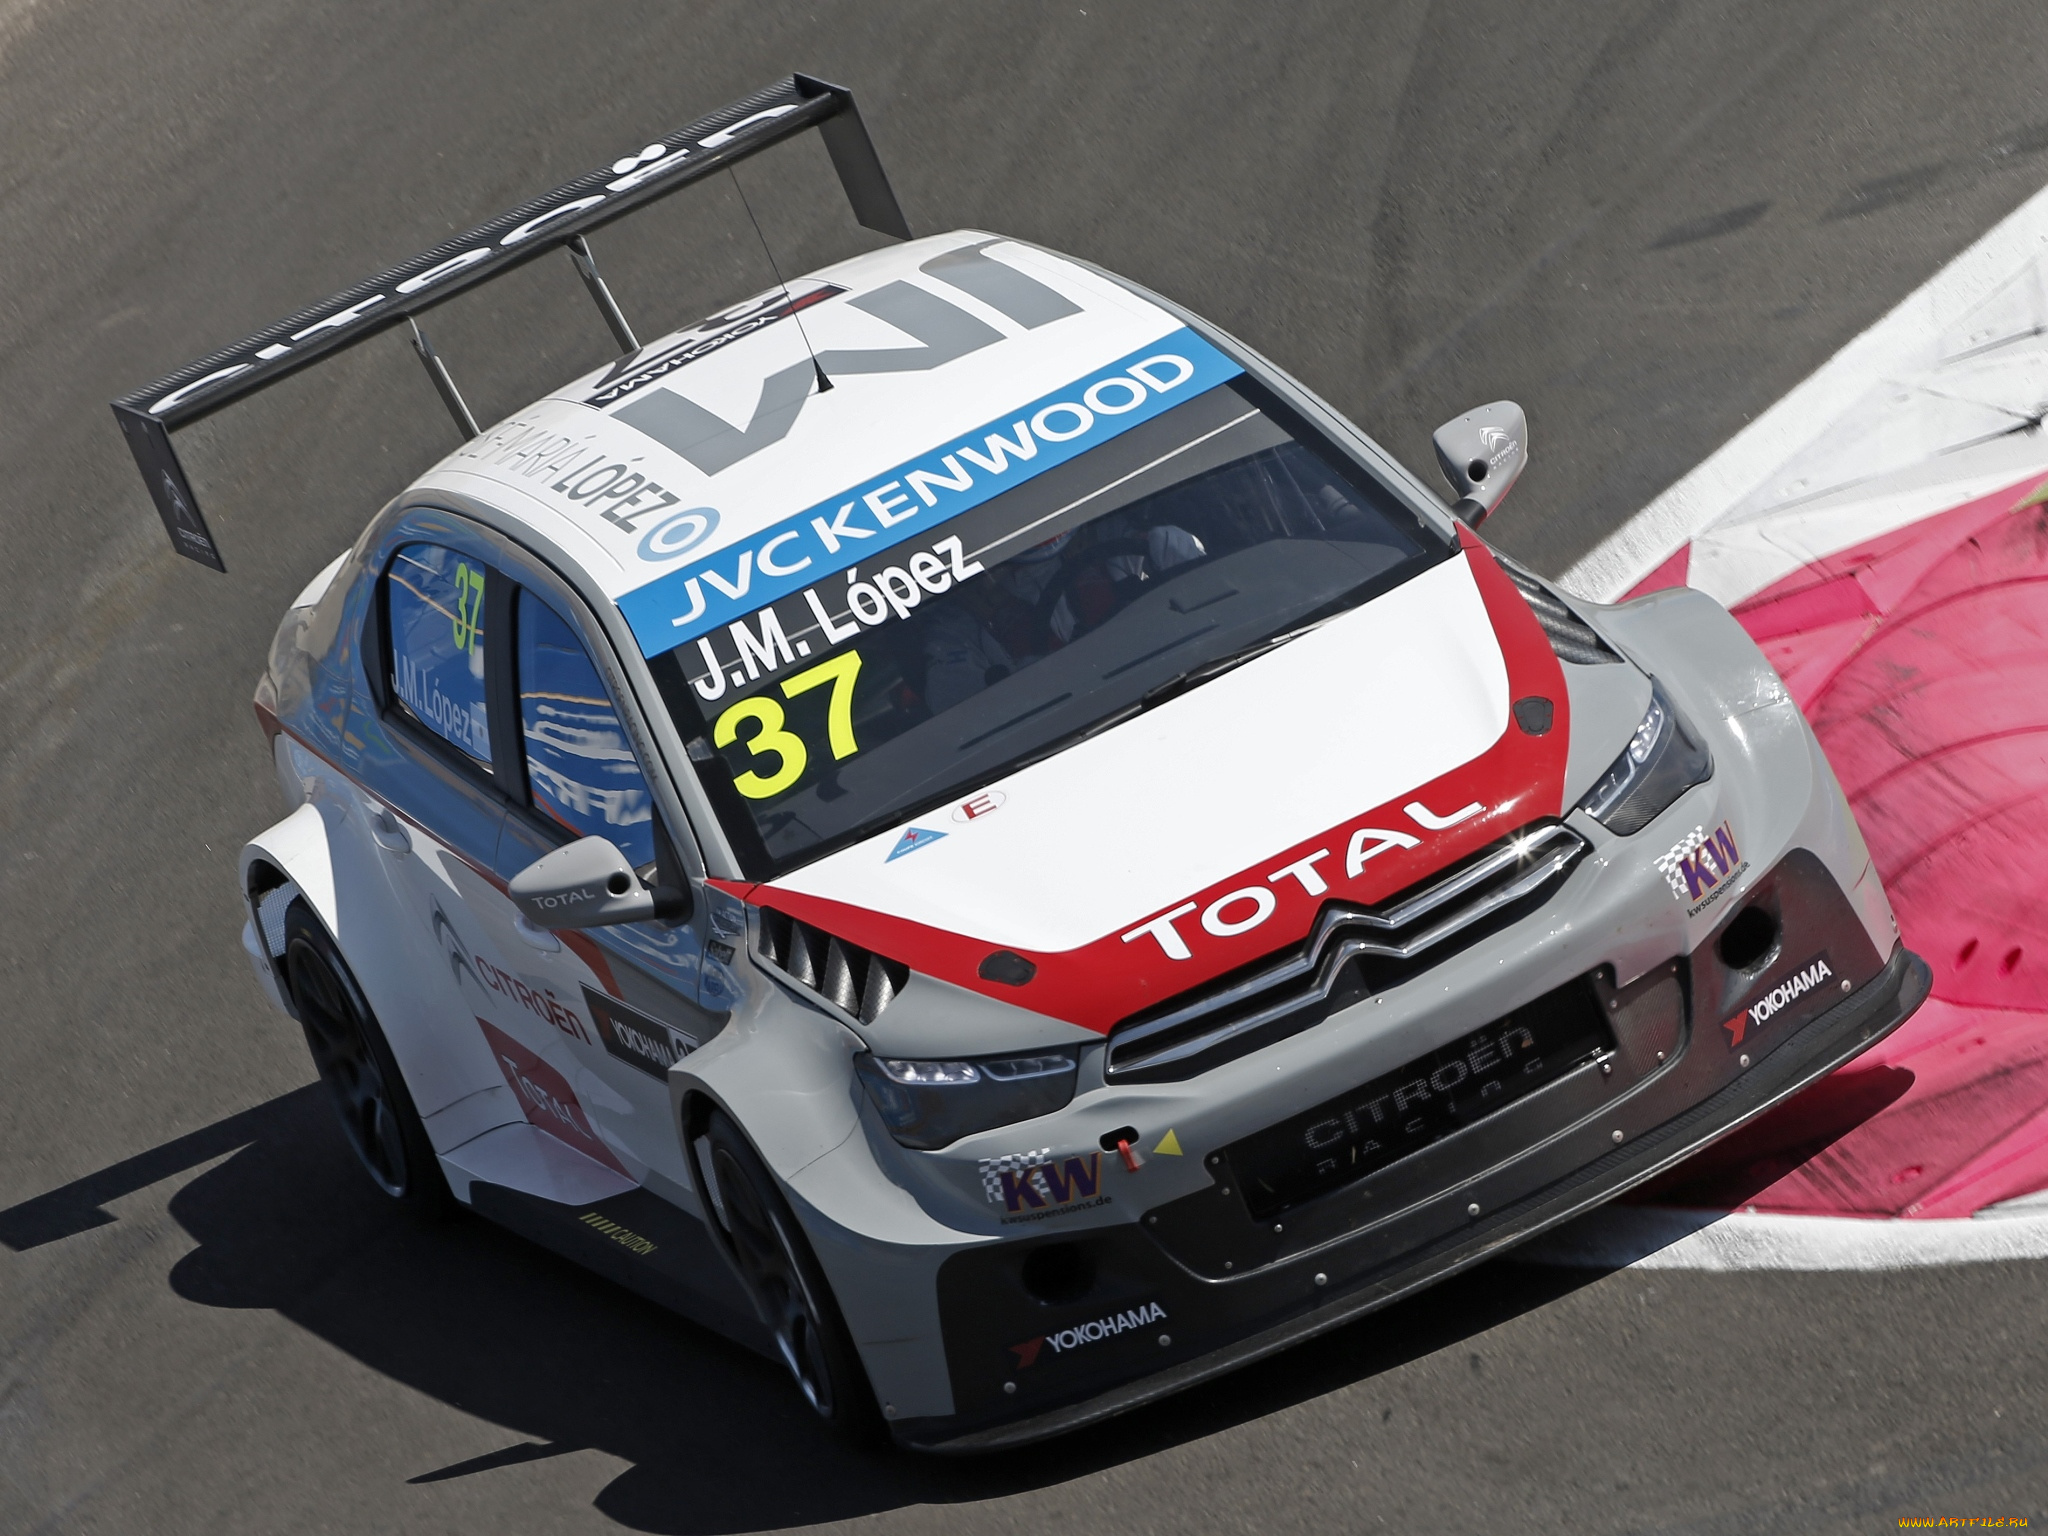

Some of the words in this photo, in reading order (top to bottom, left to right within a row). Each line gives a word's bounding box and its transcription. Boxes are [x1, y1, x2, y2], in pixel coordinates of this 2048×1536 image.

[595, 314, 779, 401] YOKOHAMA
[550, 456, 681, 534] LÓPEZ
[452, 562, 485, 656] 37
[693, 606, 812, 701] J.M.
[803, 534, 985, 645] López
[713, 649, 863, 800] 37
[962, 794, 997, 820] E
[1120, 801, 1487, 961] TOTAL
[1679, 820, 1741, 902] KW
[1687, 860, 1751, 919] kwsuspensions.de
[531, 888, 596, 910] TOTAL
[1747, 959, 1832, 1027] YOKOHAMA
[501, 1054, 594, 1141] TOTAL
[1000, 1151, 1103, 1214] KW
[1000, 1195, 1113, 1225] kwsuspensions.de
[610, 1229, 658, 1256] CAUTION
[1045, 1301, 1168, 1353] YOKOHAMA
